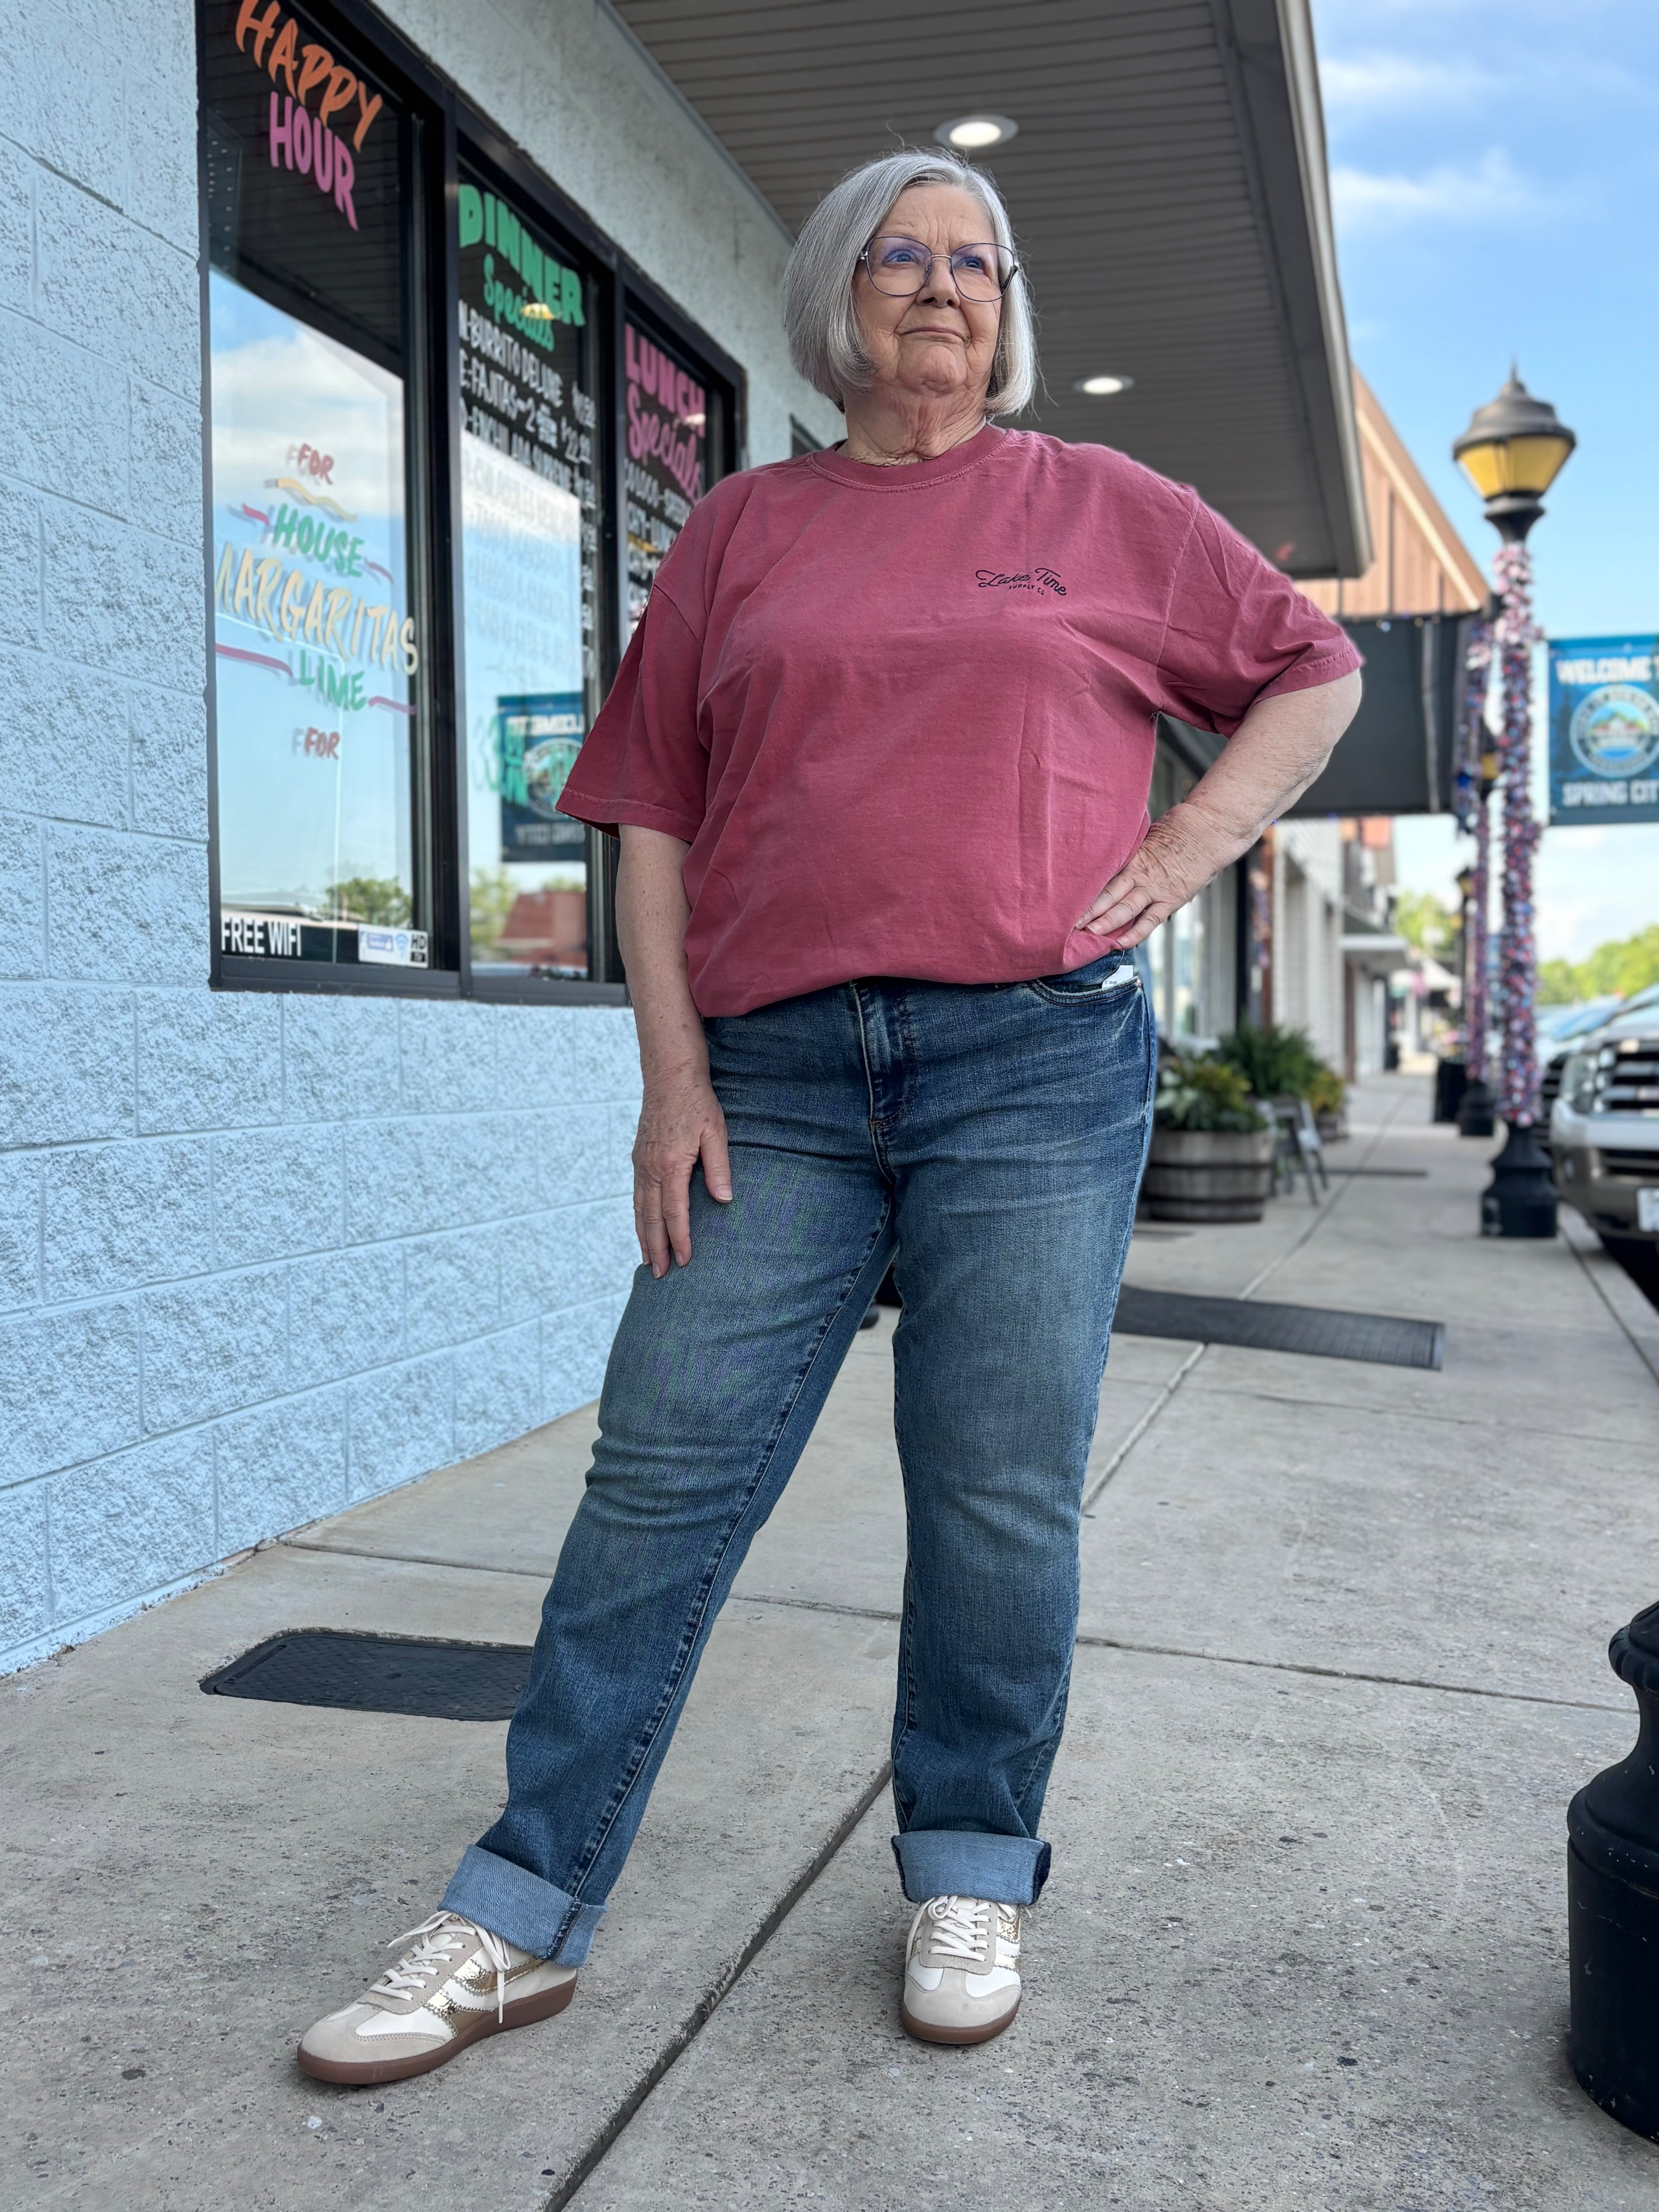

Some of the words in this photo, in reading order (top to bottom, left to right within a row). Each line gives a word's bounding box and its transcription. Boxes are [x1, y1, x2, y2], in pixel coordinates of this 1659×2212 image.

[236, 0, 383, 153] HAPPY
[269, 91, 358, 231] HOUR
[458, 184, 585, 327] DINNER
[625, 322, 706, 438] LUNCH
[298, 443, 334, 485] FOR
[273, 502, 365, 578] HOUSE
[975, 570, 1031, 587] Lake
[1035, 568, 1067, 596] Time
[300, 649, 365, 712] LIME
[1555, 655, 1652, 686] WELCOME
[304, 727, 340, 760] FOR
[1563, 781, 1628, 807] SPRING
[1630, 775, 1659, 805] CIT
[222, 916, 265, 954] FREE
[268, 920, 302, 957] WIFI
[411, 934, 426, 950] HD
